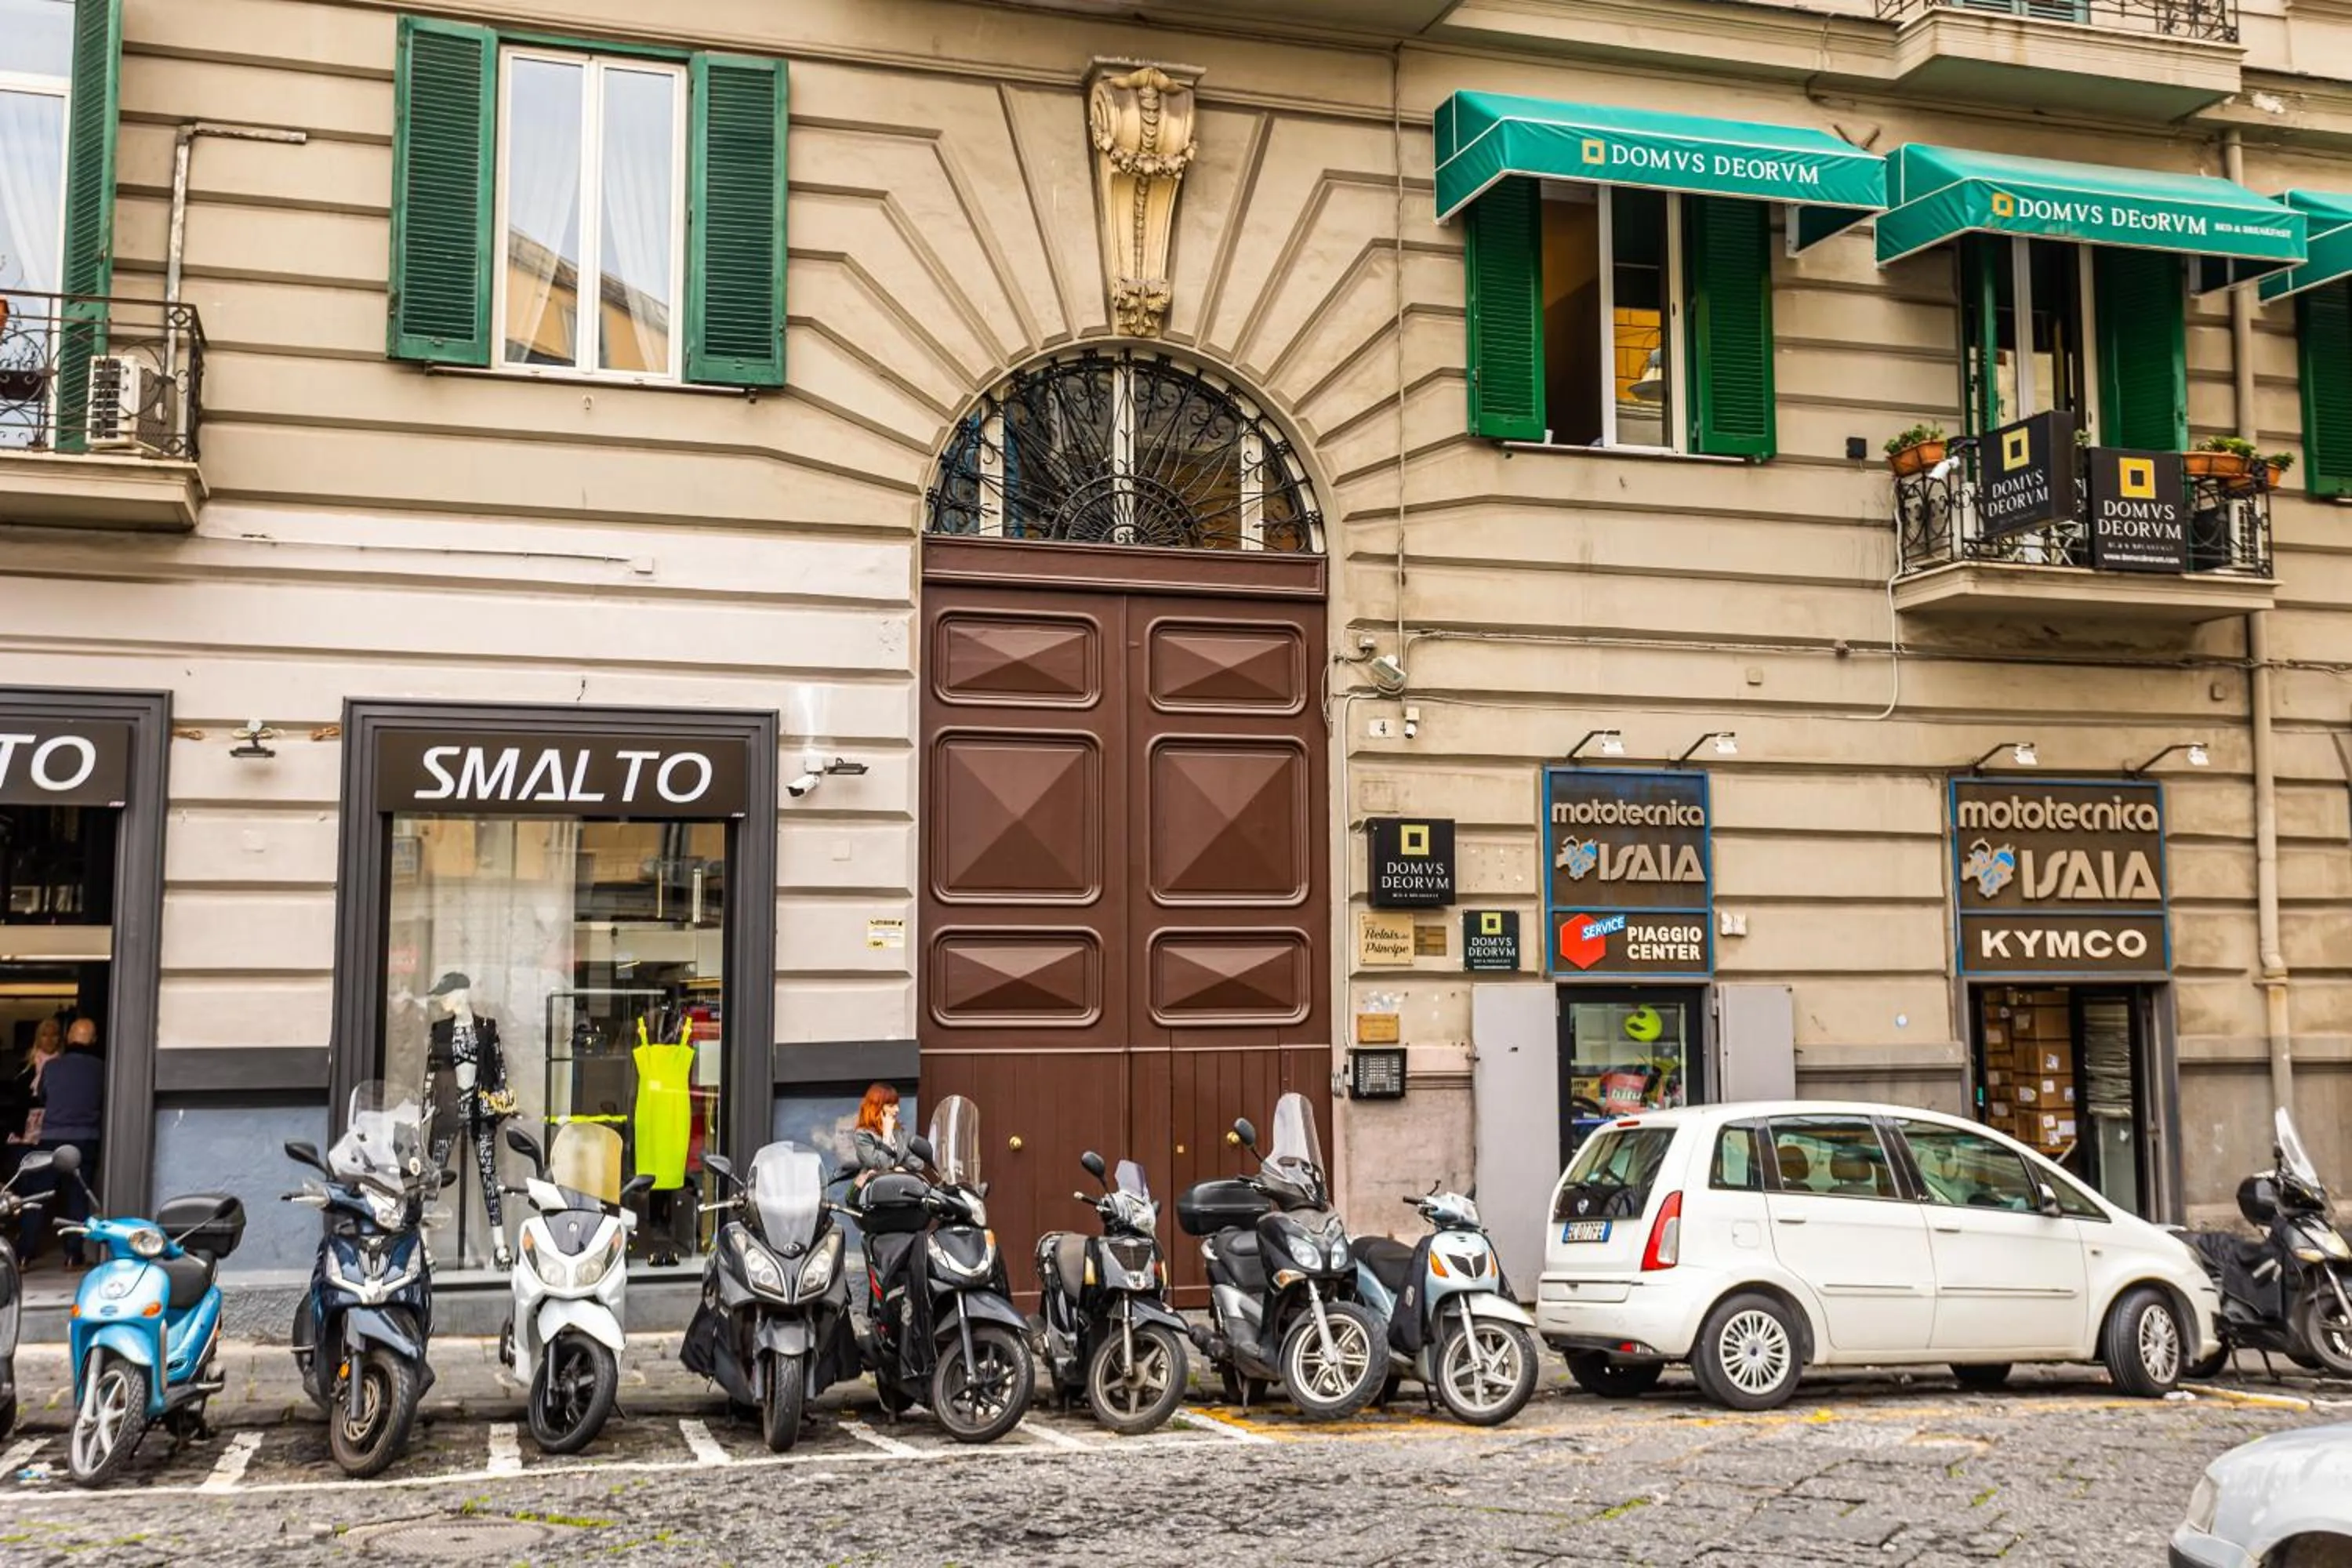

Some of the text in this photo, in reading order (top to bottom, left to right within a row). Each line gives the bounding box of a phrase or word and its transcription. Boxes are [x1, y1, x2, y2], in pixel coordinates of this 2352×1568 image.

[1611, 143, 1820, 184] DOMVS DEORVM
[2018, 198, 2208, 235] DOMVS DEORVM
[1992, 469, 2045, 499] DOMVS
[1987, 485, 2049, 517] DEORVM
[2103, 499, 2176, 521] DOMVS
[2097, 518, 2183, 540] DEORVM
[1379, 720, 1387, 735] 4
[413, 746, 713, 804] SMALTO
[1551, 798, 1706, 827] mototecnica
[1958, 795, 2159, 832] mototecnica
[1387, 862, 1445, 876] DOMVS
[1598, 843, 1707, 882] ISAIA
[2020, 849, 2161, 900] ISAIA
[1381, 876, 1450, 890] DEORVM
[1582, 916, 1626, 940] SERVICE
[1627, 926, 1703, 943] PIAGGIO
[1468, 946, 1516, 957] DEORVM
[1472, 937, 1512, 946] DOMVS
[1627, 943, 1701, 960] CENTER
[1980, 928, 2148, 959] KYMCO
